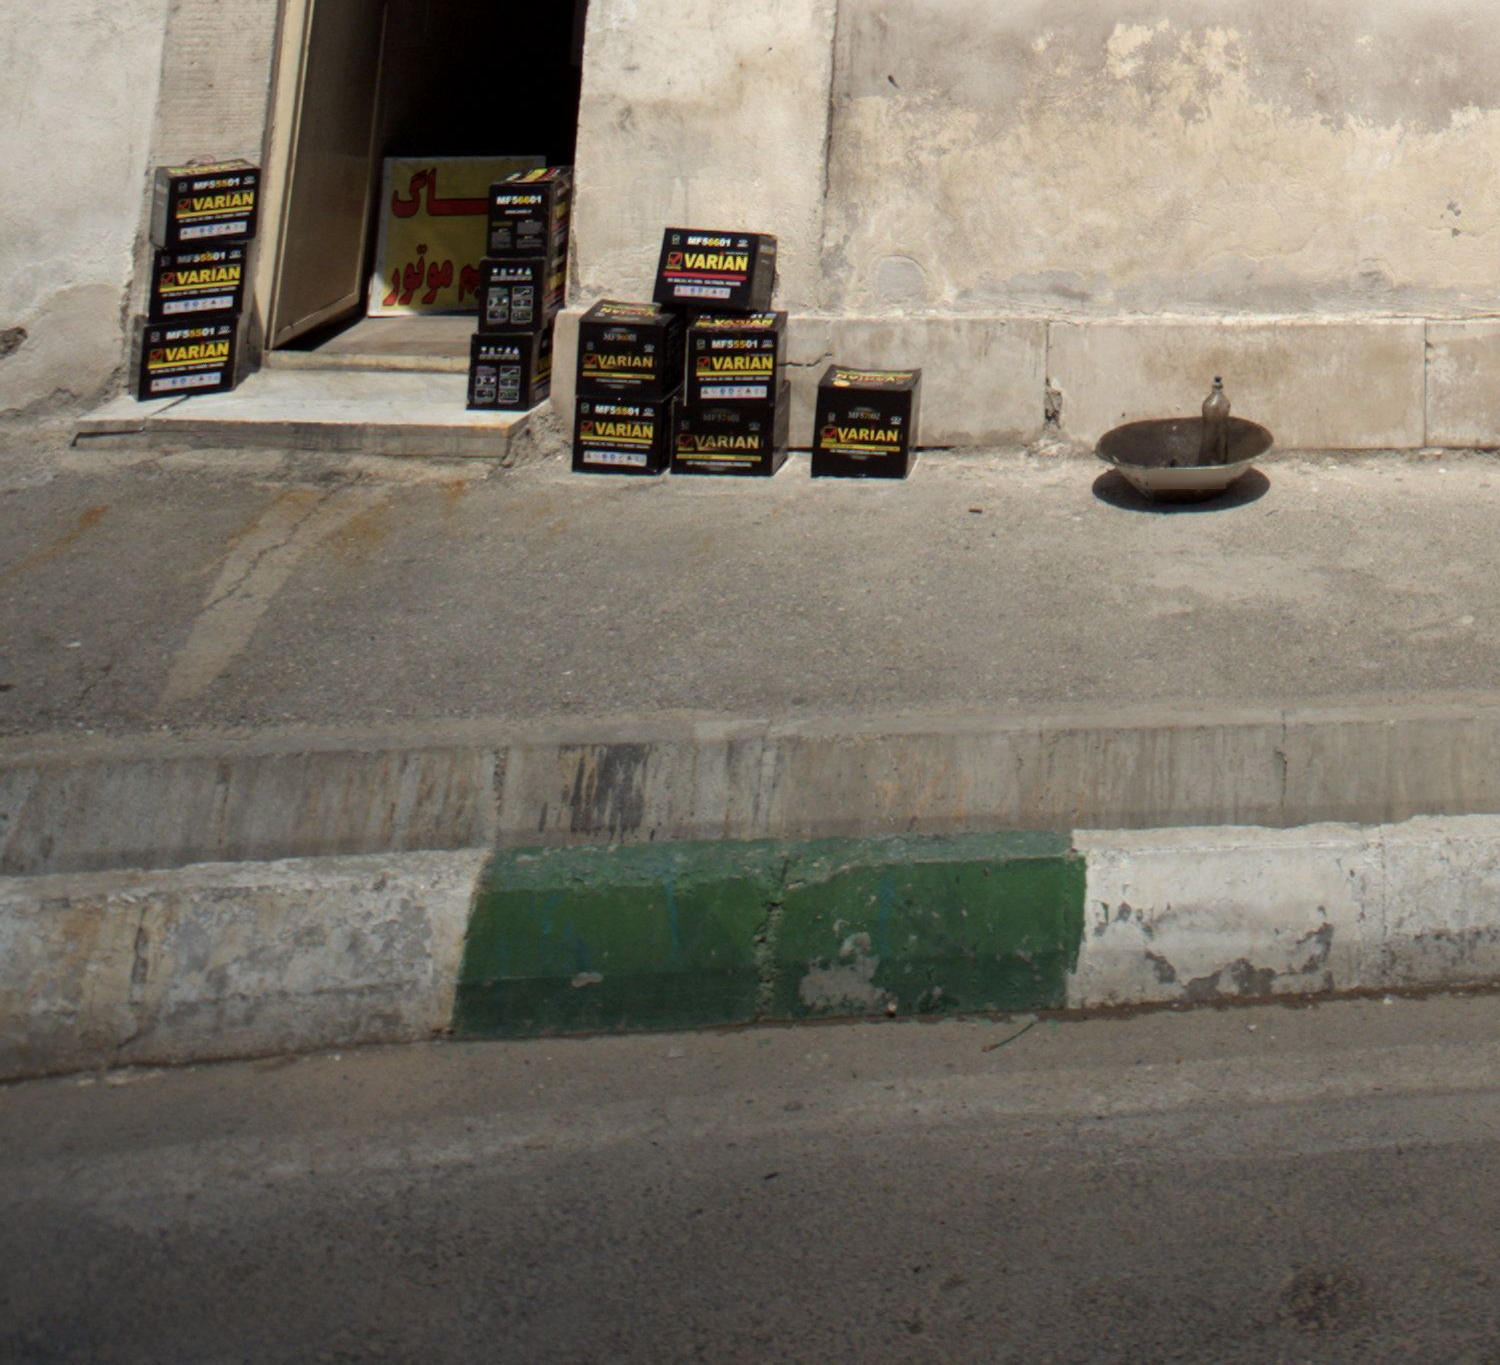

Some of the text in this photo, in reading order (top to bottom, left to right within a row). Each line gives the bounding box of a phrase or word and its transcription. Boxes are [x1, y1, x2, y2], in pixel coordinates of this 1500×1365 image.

[192, 192, 254, 210] VARIAN
[684, 253, 748, 271] VARIAN
[175, 267, 240, 285] VARIAN
[165, 341, 230, 361] VARIAN
[597, 354, 653, 368] VARIAN
[711, 355, 773, 370] VARIAN
[595, 422, 654, 439] VARIAN
[838, 427, 899, 442] VARIAN
[694, 435, 759, 449] VARIAN
